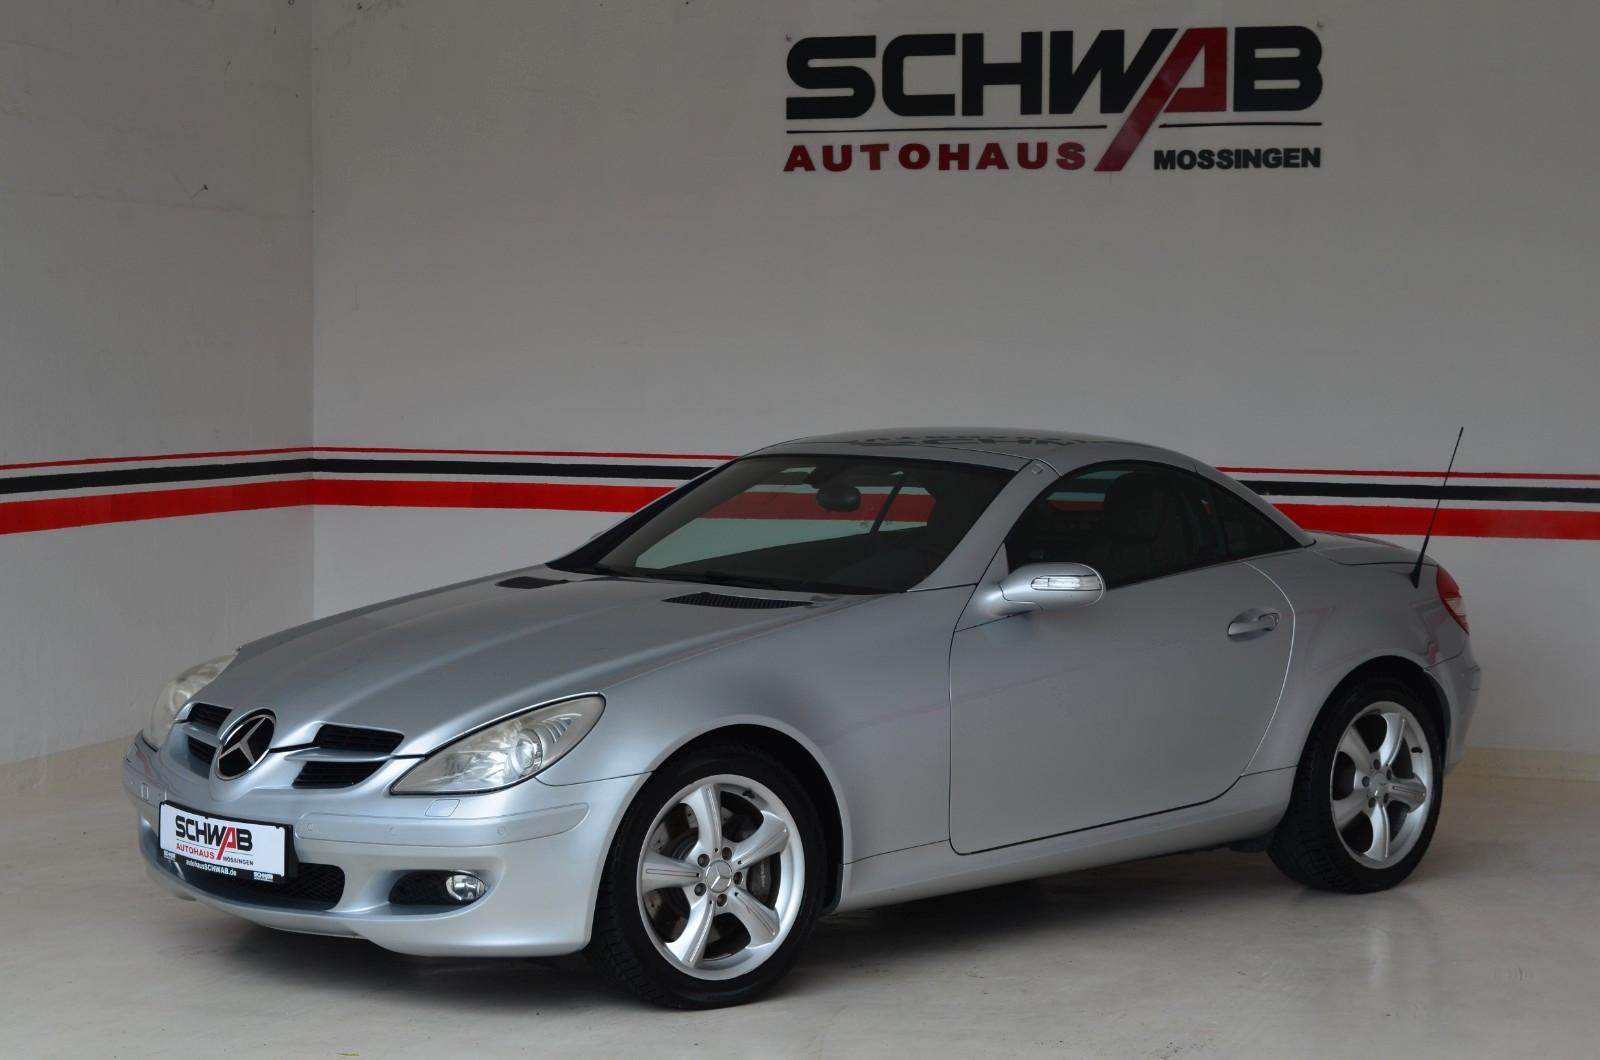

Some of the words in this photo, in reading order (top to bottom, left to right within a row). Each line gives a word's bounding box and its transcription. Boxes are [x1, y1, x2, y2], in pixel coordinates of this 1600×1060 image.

[786, 26, 1323, 171] SCHWAB
[784, 142, 1086, 171] AUTOHAUS
[1154, 147, 1322, 170] MOSSINGEN
[175, 815, 253, 860] SCHWAB
[176, 843, 215, 859] AUTOHAUS
